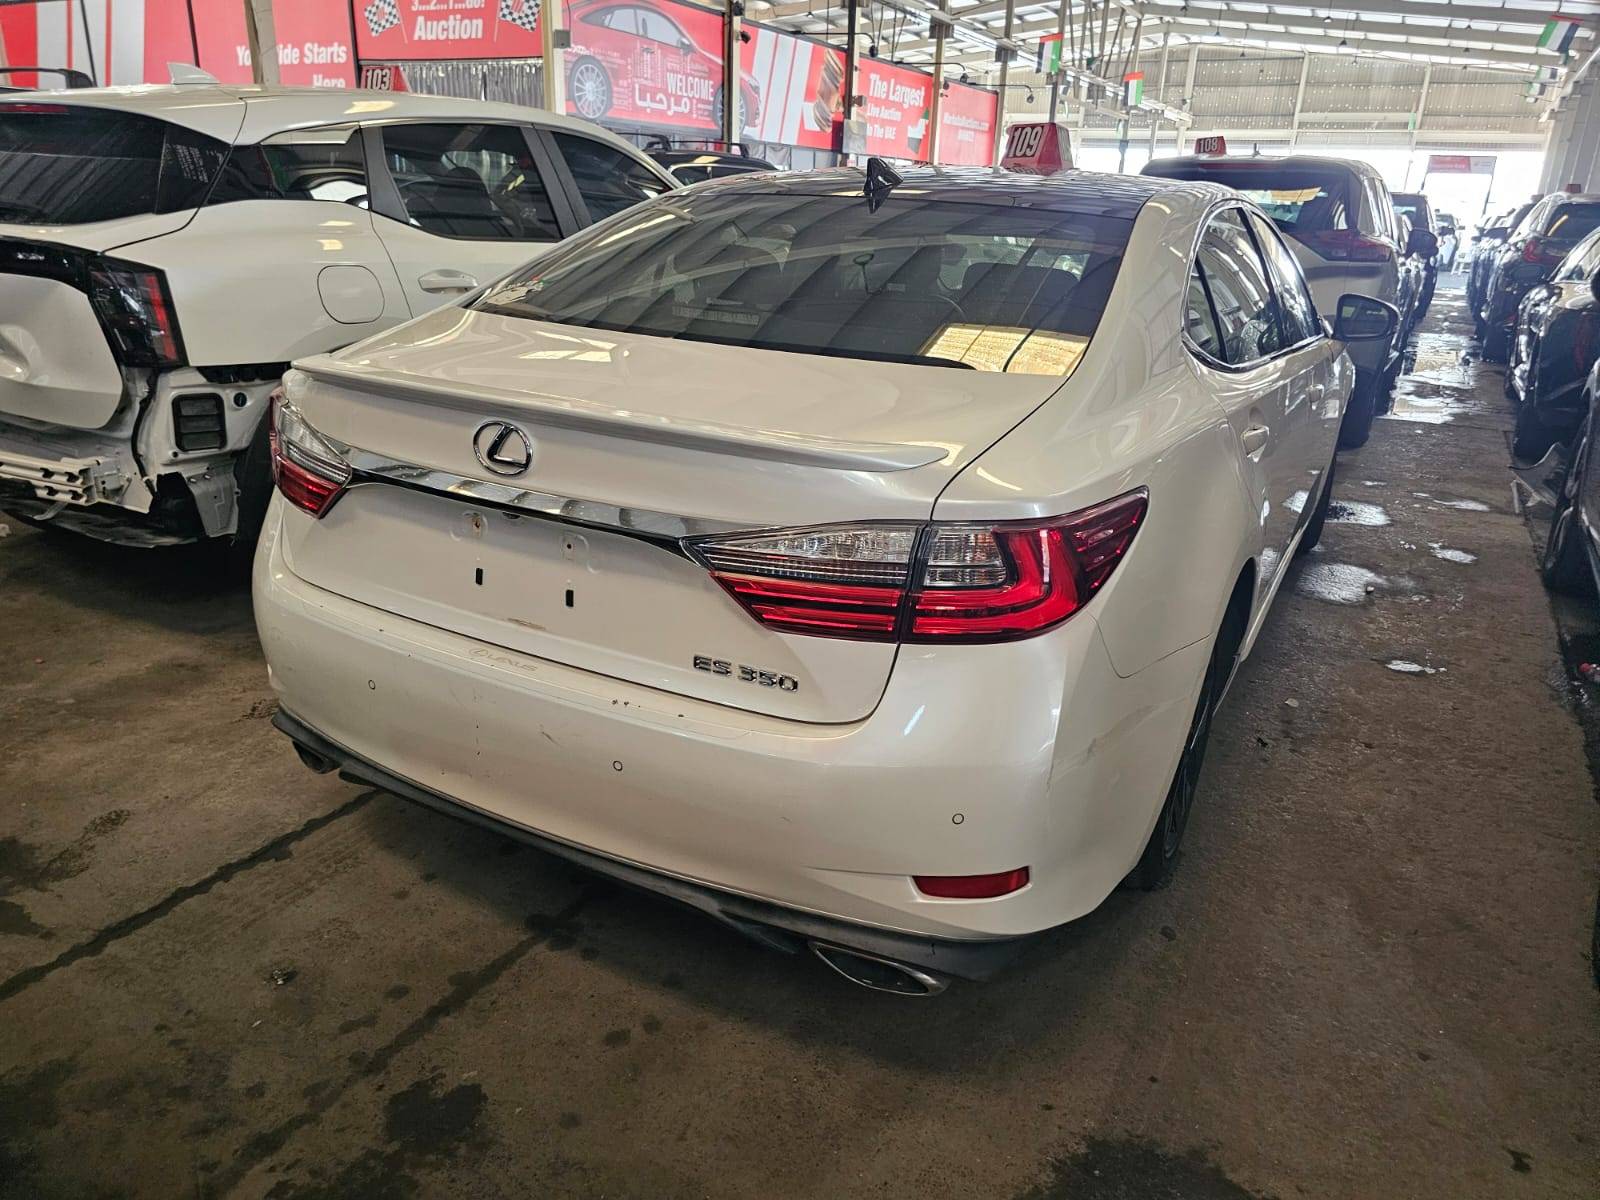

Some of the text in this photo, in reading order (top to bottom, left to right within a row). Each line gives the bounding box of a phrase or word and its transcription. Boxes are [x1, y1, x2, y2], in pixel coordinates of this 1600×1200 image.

[414, 14, 483, 40] Auction
[236, 42, 347, 67] Yo ide Starts
[367, 69, 390, 90] 103
[667, 71, 714, 101] WELCOME
[869, 73, 925, 109] The Largest
[635, 83, 690, 116] مرحبا
[1008, 126, 1042, 158] 109
[1199, 138, 1218, 153] 108
[693, 655, 799, 692] ES 350
